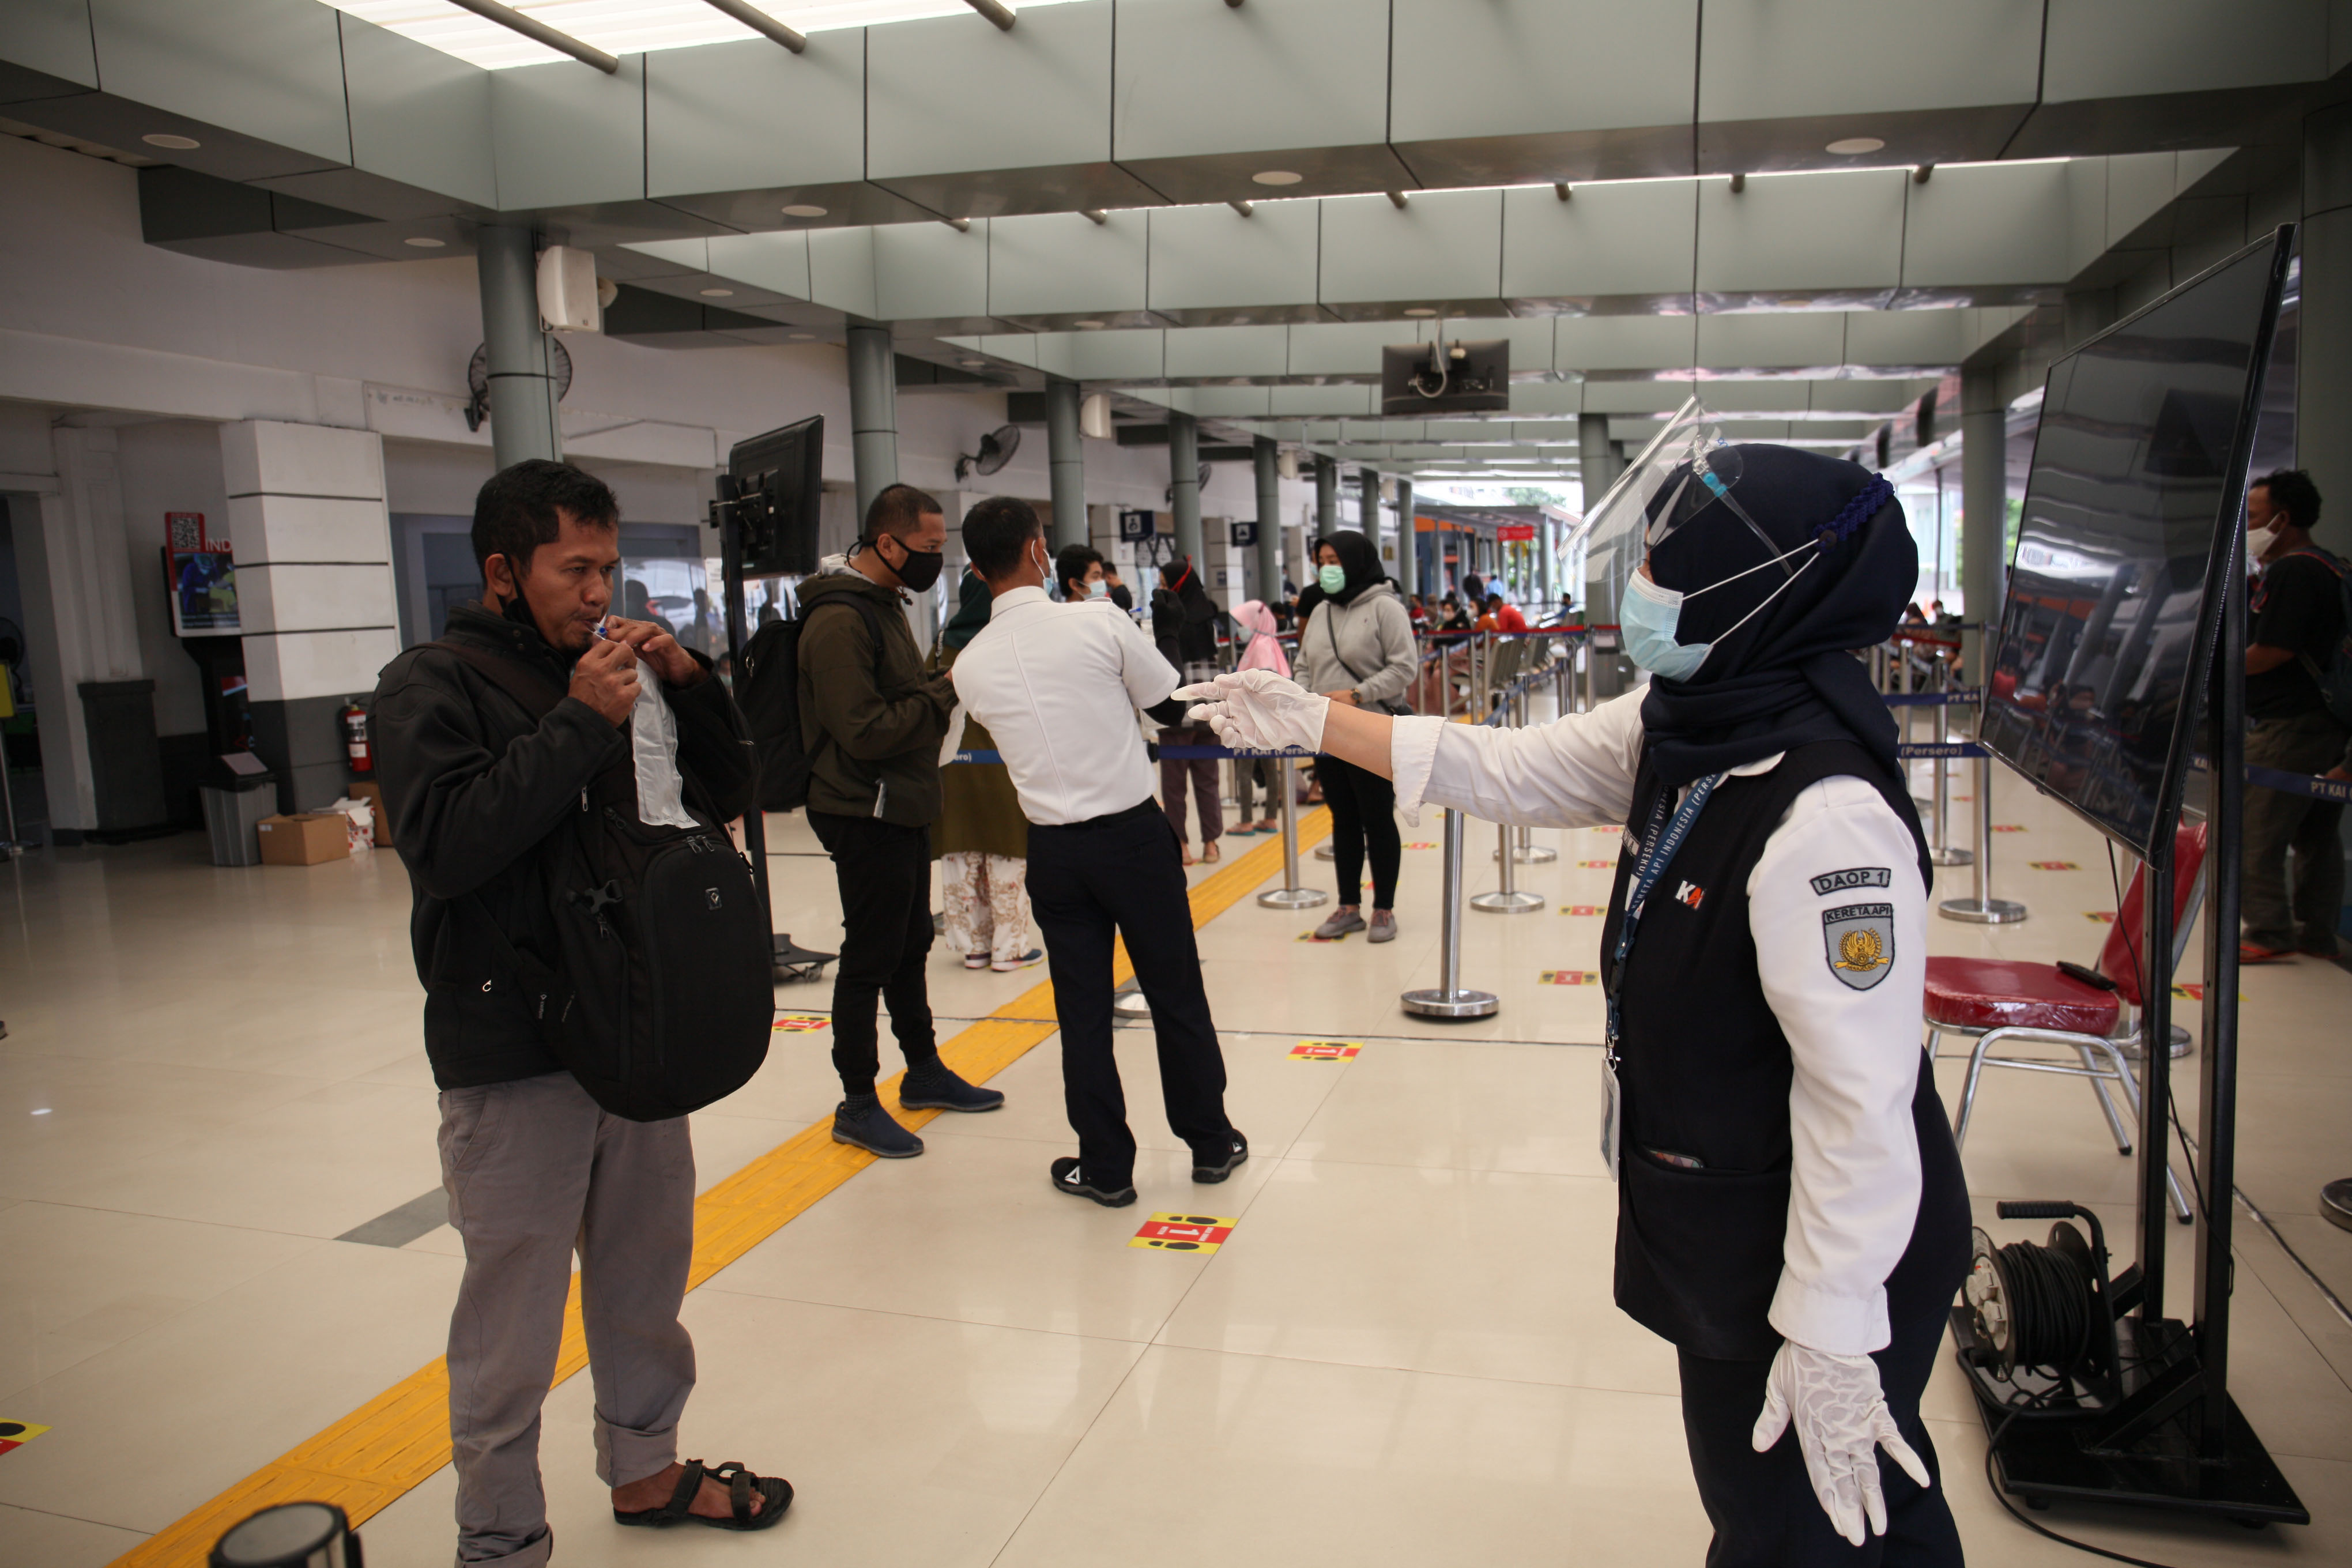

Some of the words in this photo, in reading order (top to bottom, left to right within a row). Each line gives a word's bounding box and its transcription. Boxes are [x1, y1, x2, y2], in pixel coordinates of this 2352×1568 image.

[1901, 746, 1963, 756] (Persero)
[2310, 781, 2326, 794] PT
[2329, 783, 2346, 798] KAI
[1650, 857, 1664, 875] API
[1660, 806, 1694, 855] INDONESIA
[1819, 871, 1870, 891] DAOP
[1877, 871, 1884, 884] 1
[1826, 906, 1871, 922] KERETA
[1871, 906, 1890, 915] API
